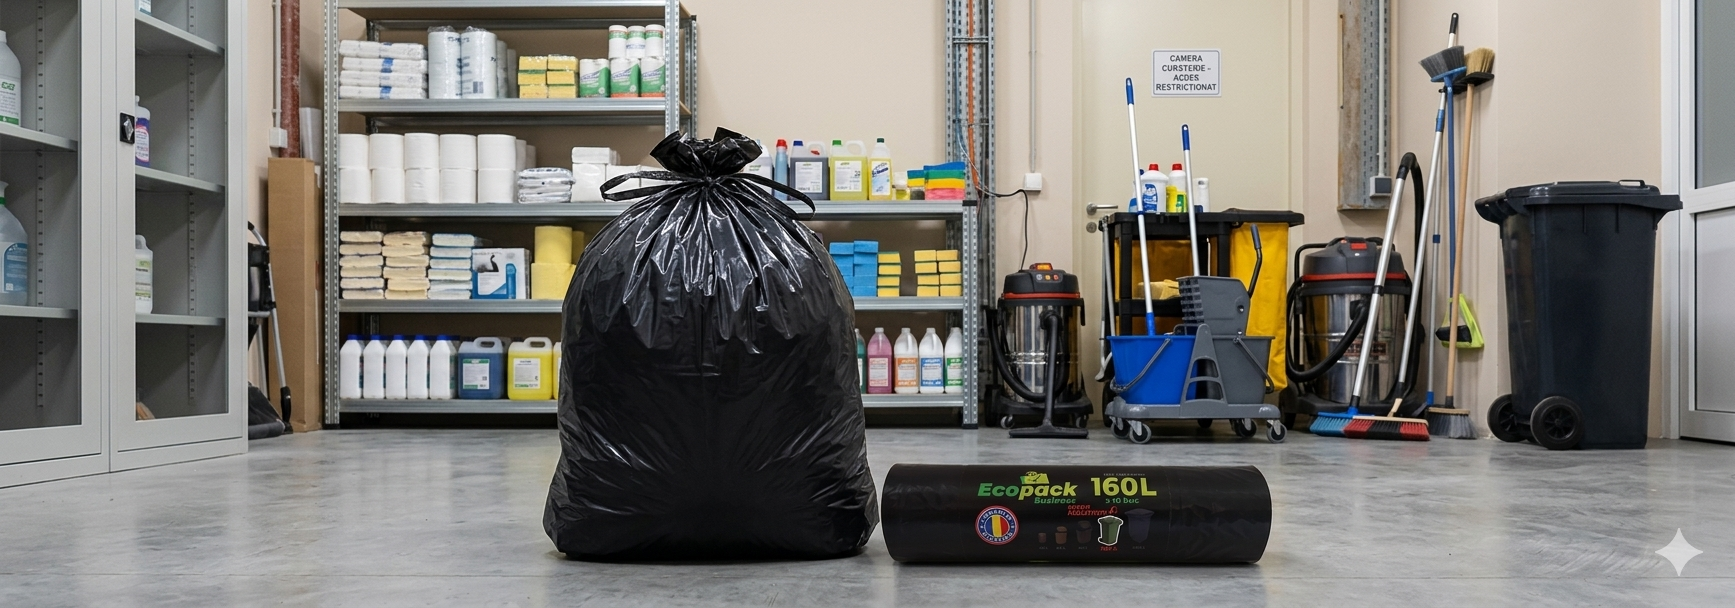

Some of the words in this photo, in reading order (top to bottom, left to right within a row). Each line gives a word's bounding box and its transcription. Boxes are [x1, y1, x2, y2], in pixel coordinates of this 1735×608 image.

[1155, 83, 1217, 91] RESTRICTIONAT
[977, 481, 1079, 501] Ecopack
[1090, 476, 1158, 497] 160L
